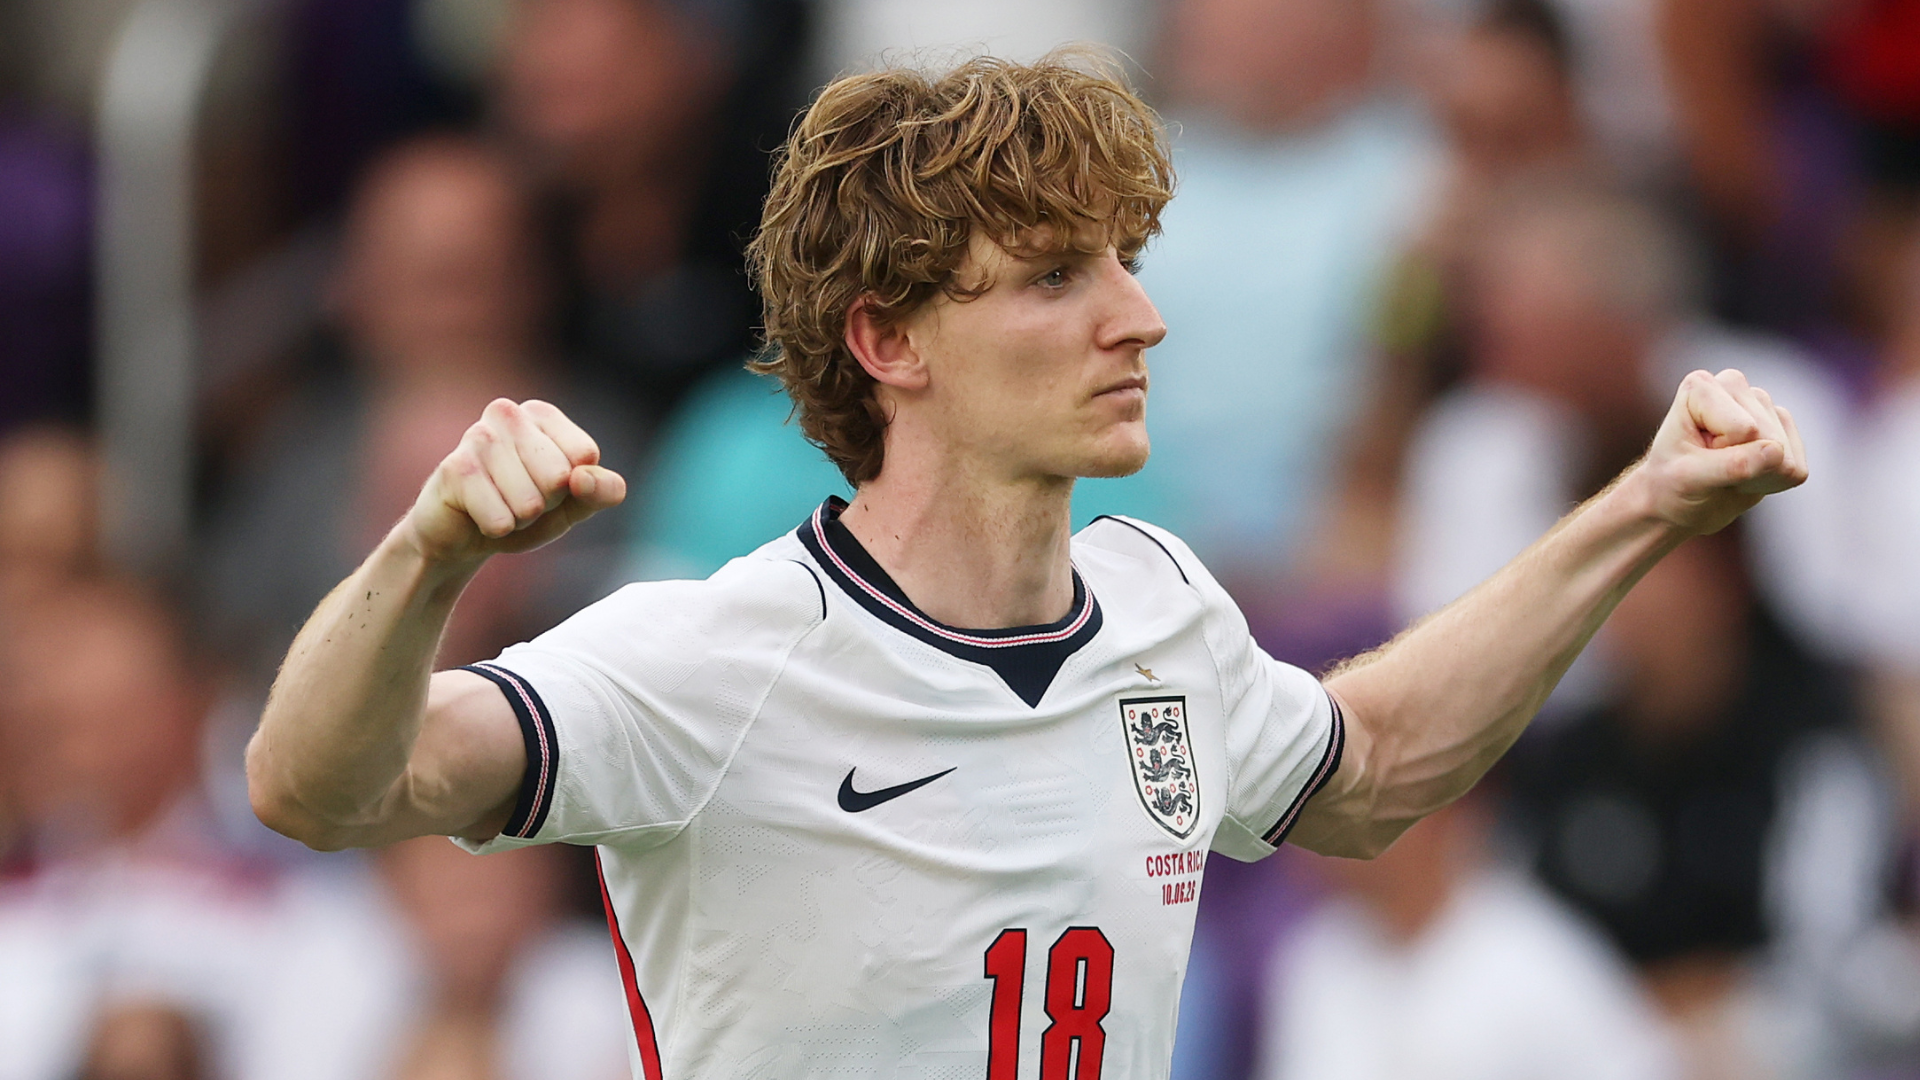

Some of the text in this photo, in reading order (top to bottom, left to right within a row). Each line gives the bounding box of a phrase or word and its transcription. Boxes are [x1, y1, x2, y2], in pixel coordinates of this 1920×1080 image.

[1146, 853, 1184, 877] COSTA
[1162, 880, 1196, 906] 10.06.26
[984, 926, 1115, 1080] 18
